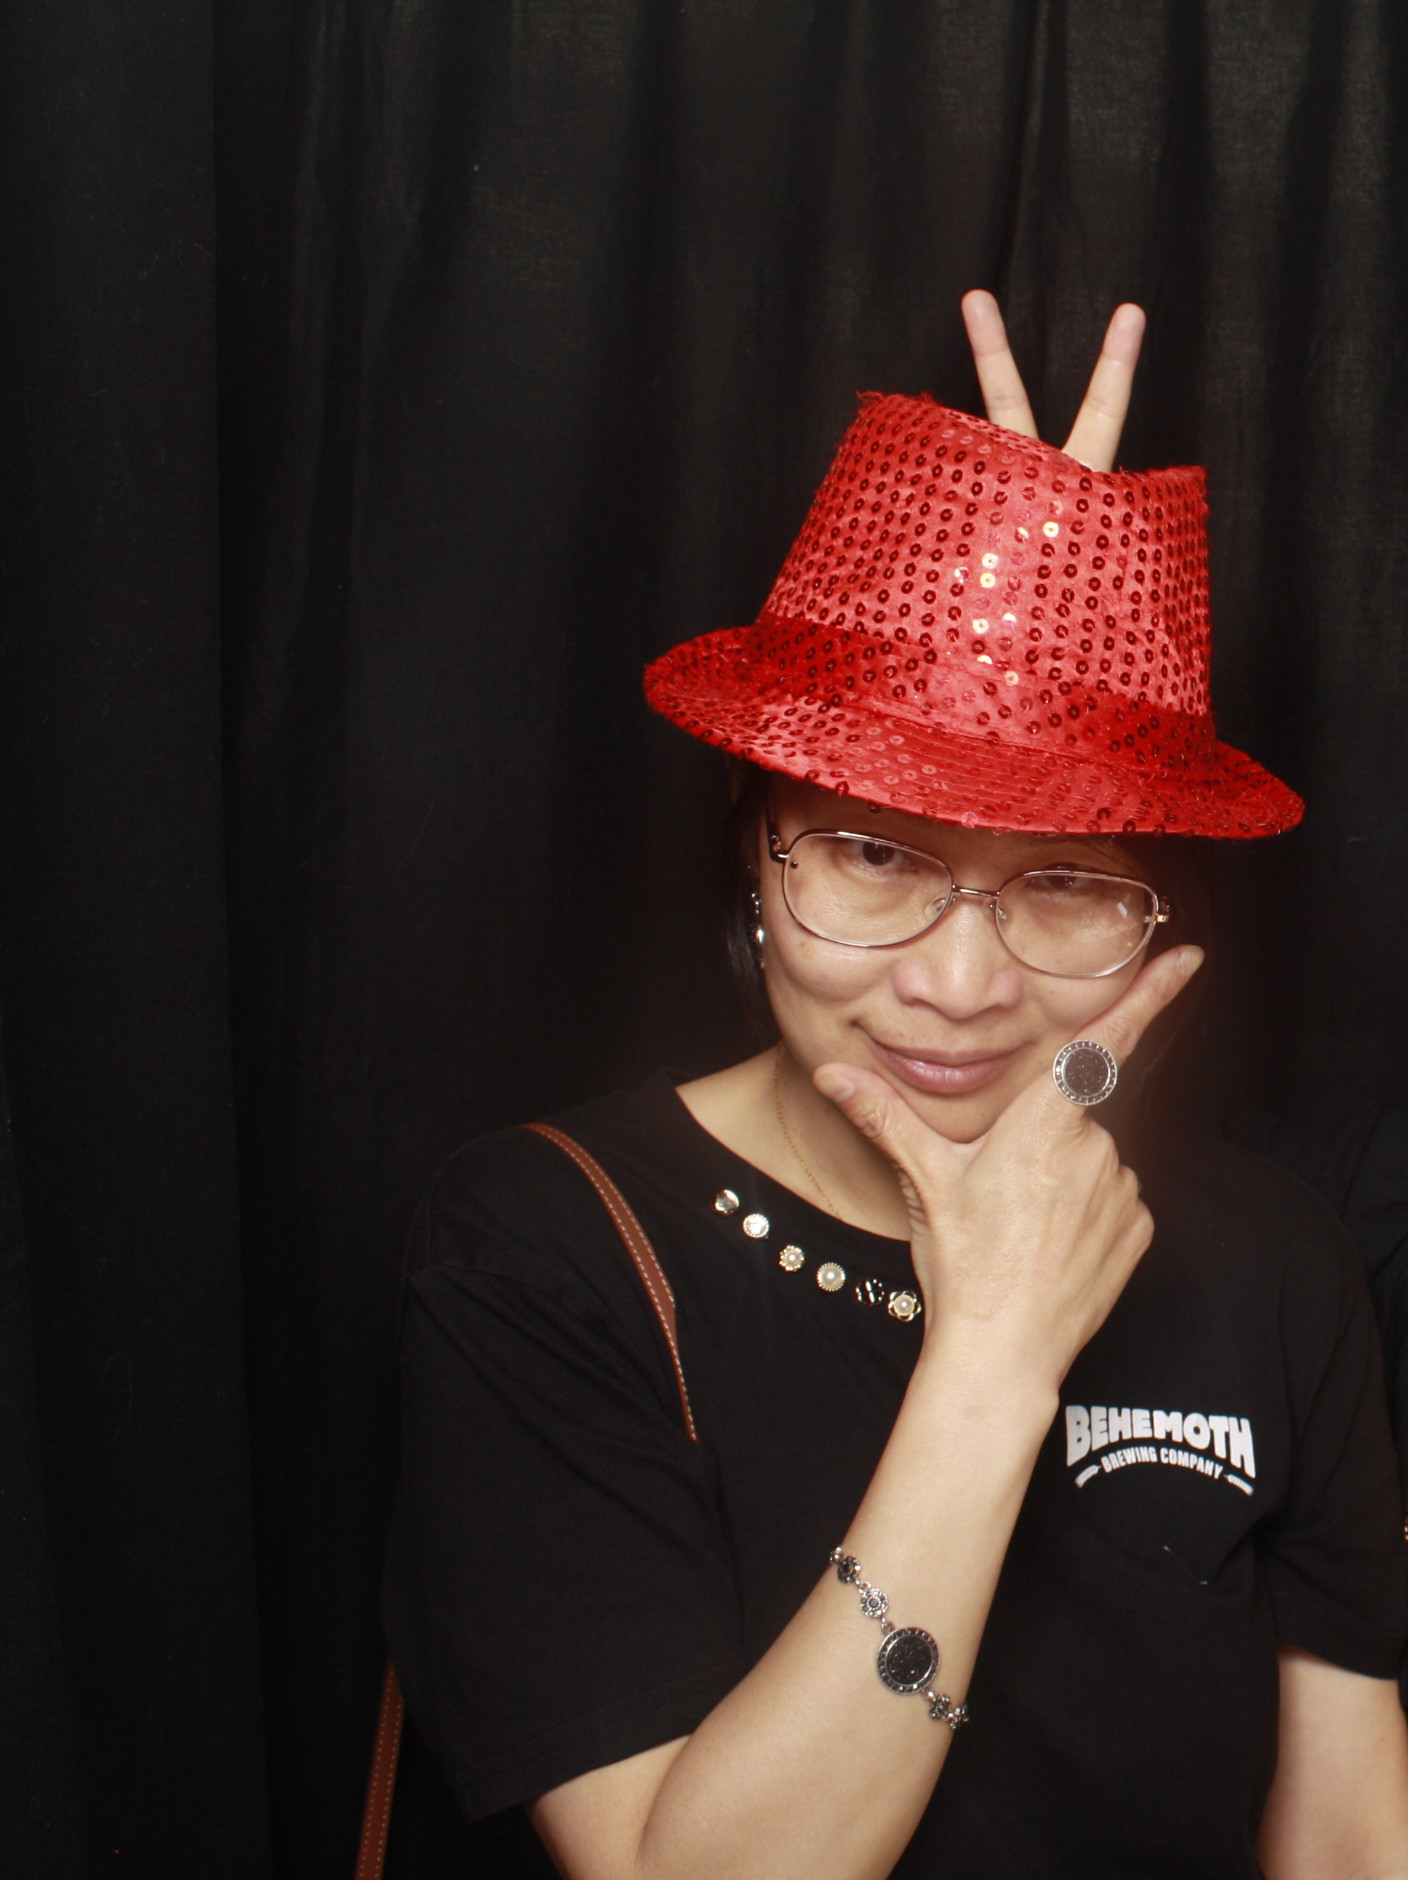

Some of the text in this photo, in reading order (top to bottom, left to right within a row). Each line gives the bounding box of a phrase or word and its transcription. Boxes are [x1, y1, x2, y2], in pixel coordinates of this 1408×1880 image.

[1065, 1404, 1256, 1478] BEHEMOTH
[1101, 1446, 1223, 1479] BREWING COMPANY
